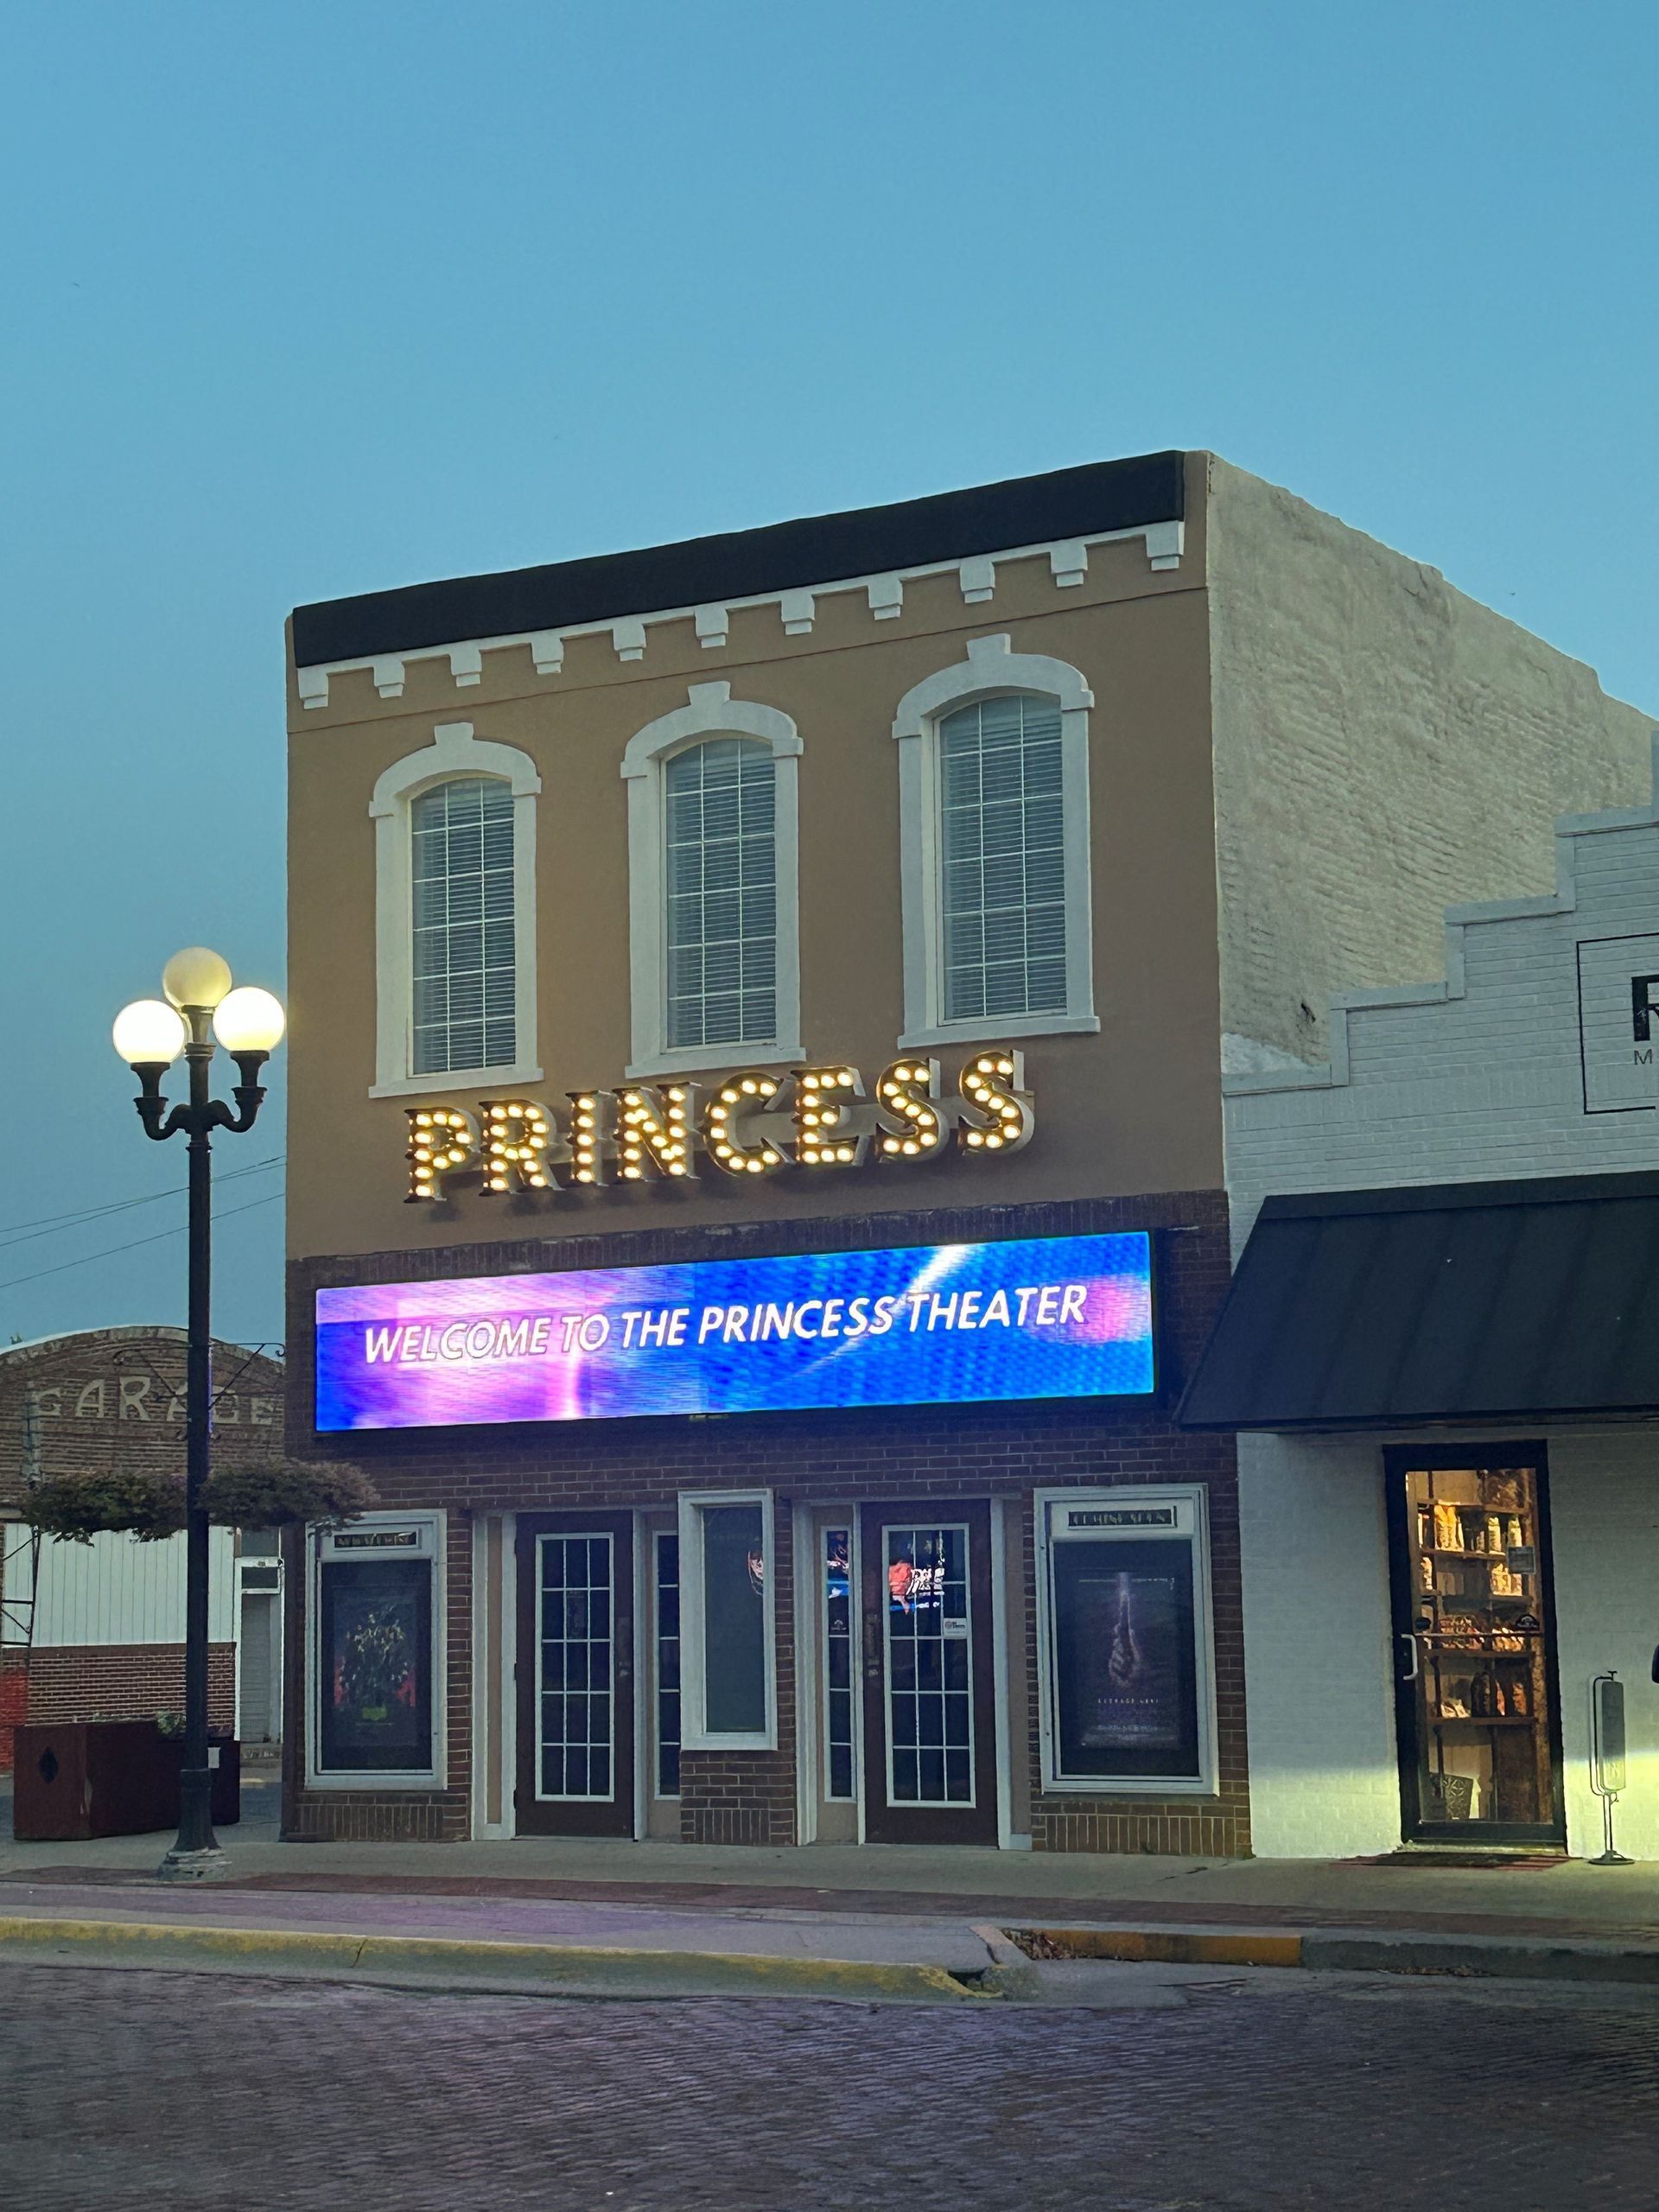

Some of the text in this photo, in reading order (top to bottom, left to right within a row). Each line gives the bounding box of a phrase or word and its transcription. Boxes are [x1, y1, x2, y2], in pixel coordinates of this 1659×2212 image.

[404, 1048, 1035, 1203] PRINCESS
[365, 1284, 1088, 1364] WELCOME TO THE PRINCESS THEATER
